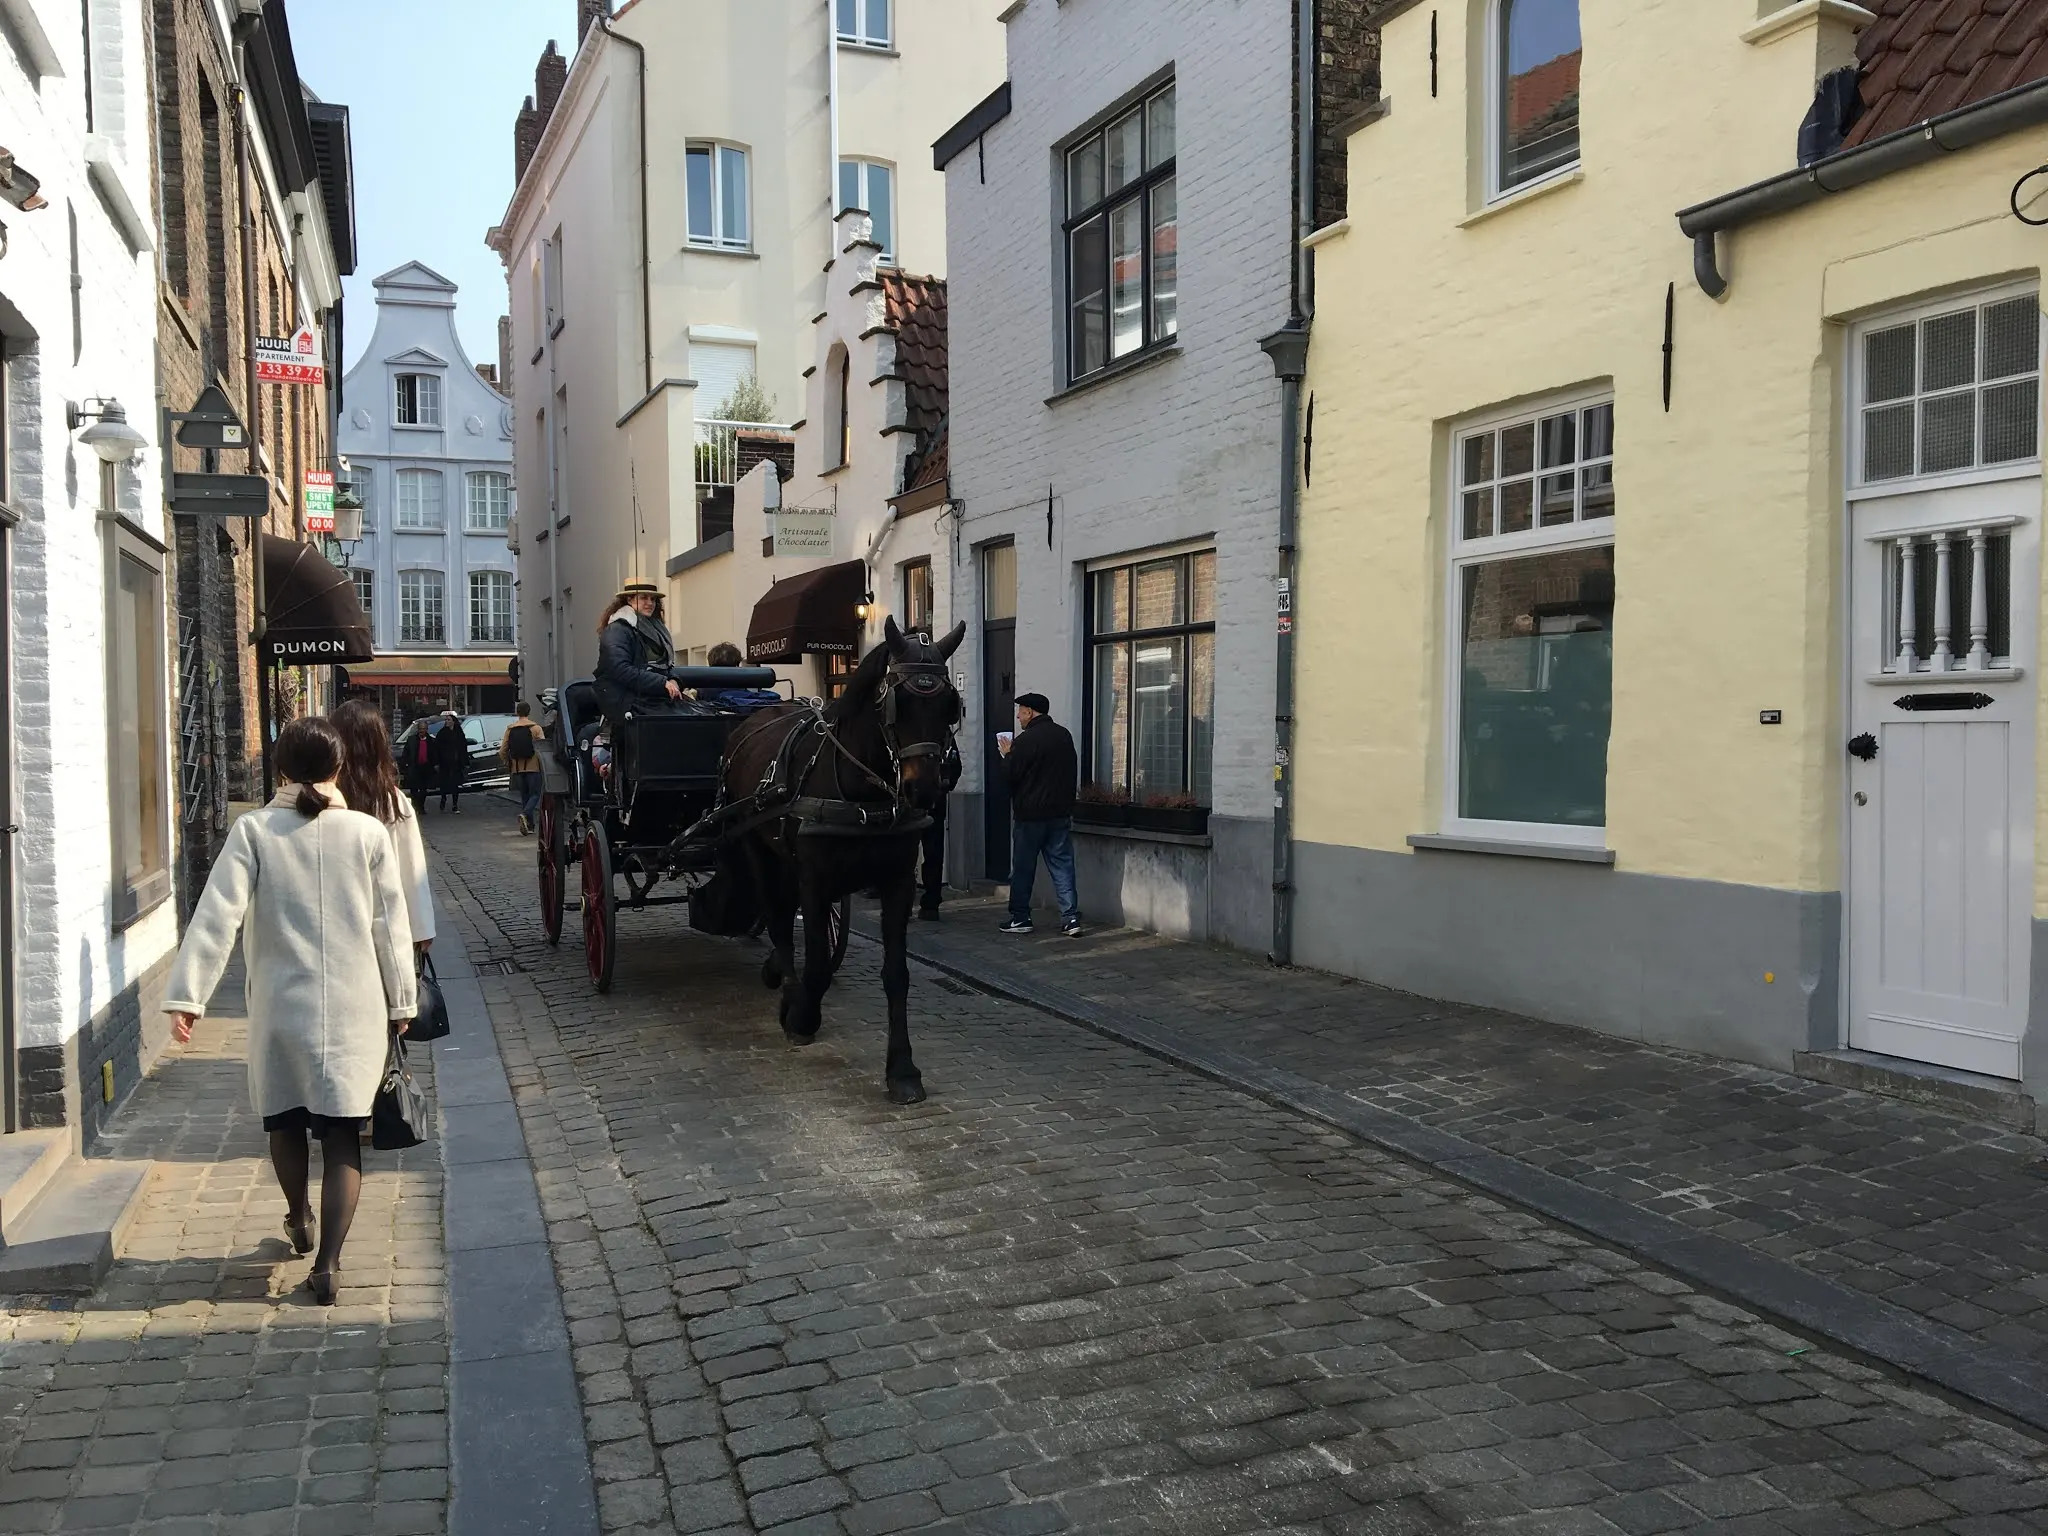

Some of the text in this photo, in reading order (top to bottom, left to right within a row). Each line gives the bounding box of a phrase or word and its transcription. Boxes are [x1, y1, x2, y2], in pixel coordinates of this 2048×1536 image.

[256, 337, 290, 350] HUUR
[256, 352, 305, 362] PPARTEMENT
[266, 364, 282, 375] 33
[287, 365, 302, 376] 39
[306, 367, 322, 378] 76
[307, 472, 332, 484] HUUR
[308, 492, 333, 502] SMET
[306, 501, 332, 510] UPEYE
[780, 527, 829, 536] Artisanale
[778, 537, 830, 546] Chocolatier
[273, 641, 345, 654] DUMON
[750, 638, 788, 657] PUR CHOCOLAT
[820, 643, 853, 651] CHOCOLAT
